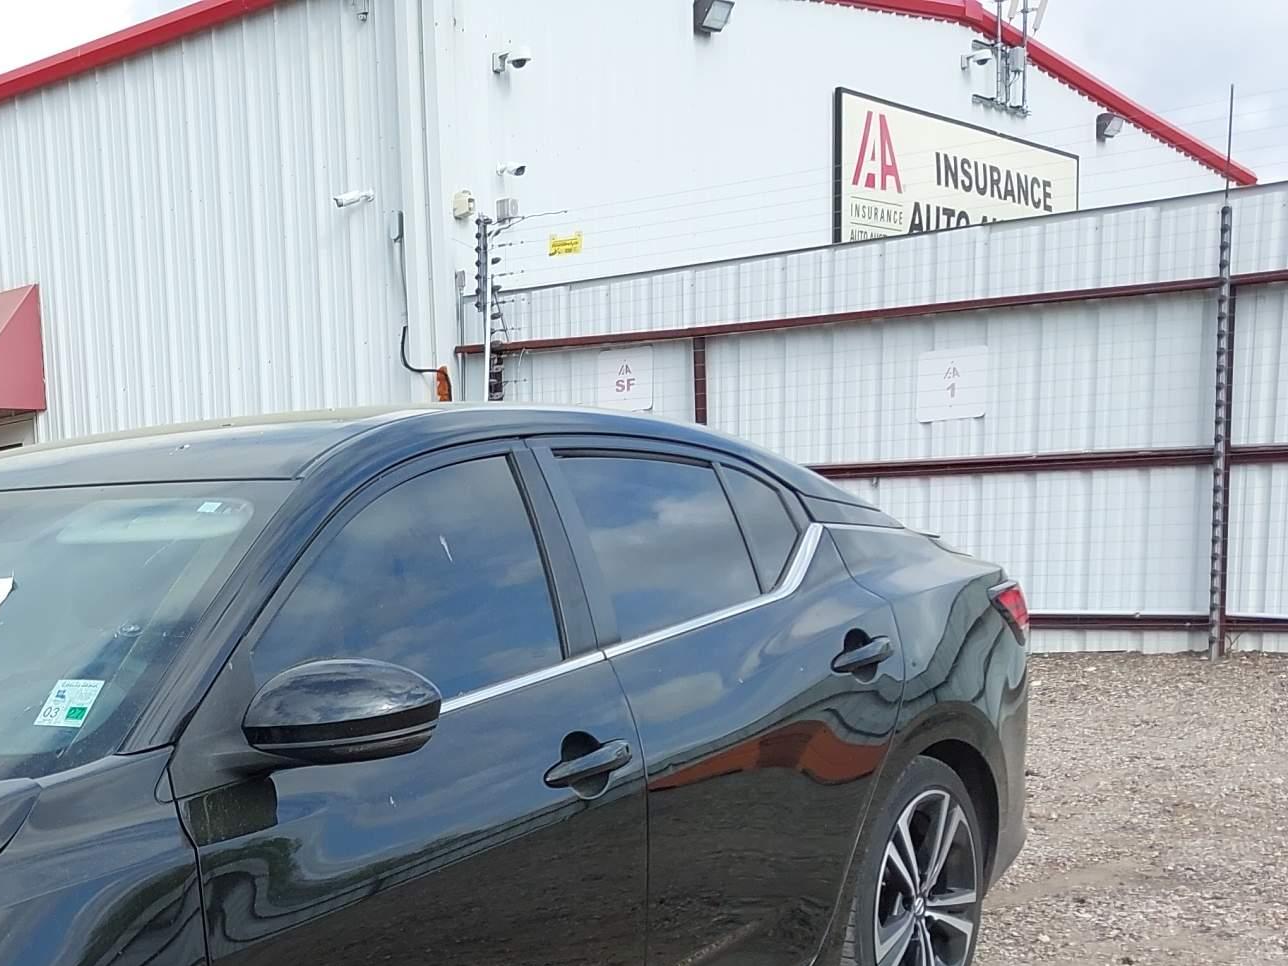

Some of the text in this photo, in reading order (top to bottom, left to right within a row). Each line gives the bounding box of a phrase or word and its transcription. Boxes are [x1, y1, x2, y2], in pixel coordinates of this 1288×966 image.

[935, 151, 1053, 212] INSURANCE
[850, 203, 903, 225] INSURANCE
[909, 201, 971, 234] AUTO
[615, 378, 635, 393] SF
[946, 382, 956, 398] 1
[42, 706, 60, 718] 03
